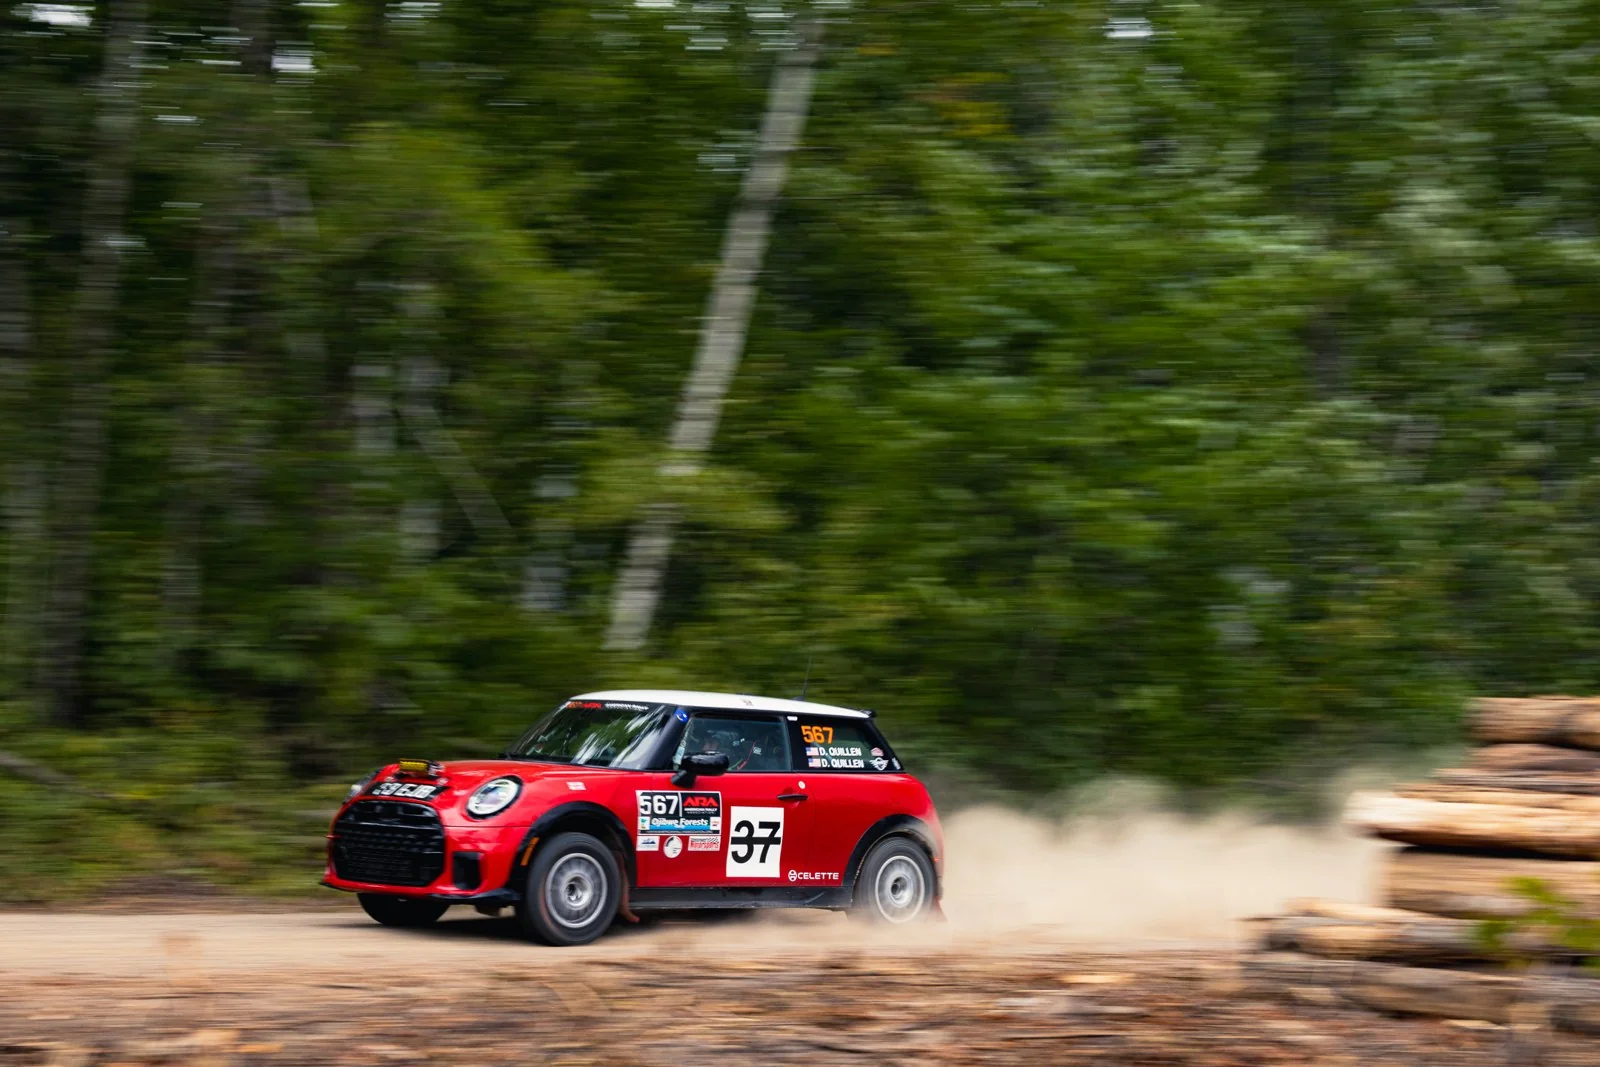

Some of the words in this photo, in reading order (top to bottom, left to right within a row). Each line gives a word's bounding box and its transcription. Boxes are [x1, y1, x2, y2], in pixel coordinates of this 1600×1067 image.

[801, 725, 833, 744] 567
[819, 747, 828, 756] D.
[829, 747, 862, 756] QUILLEN
[822, 759, 831, 768] D.
[831, 759, 864, 768] QUILLEN
[639, 795, 678, 815] 567
[683, 796, 719, 807] ARA
[680, 818, 709, 826] Forests
[731, 820, 781, 864] 37
[797, 872, 840, 880] CELETTE
